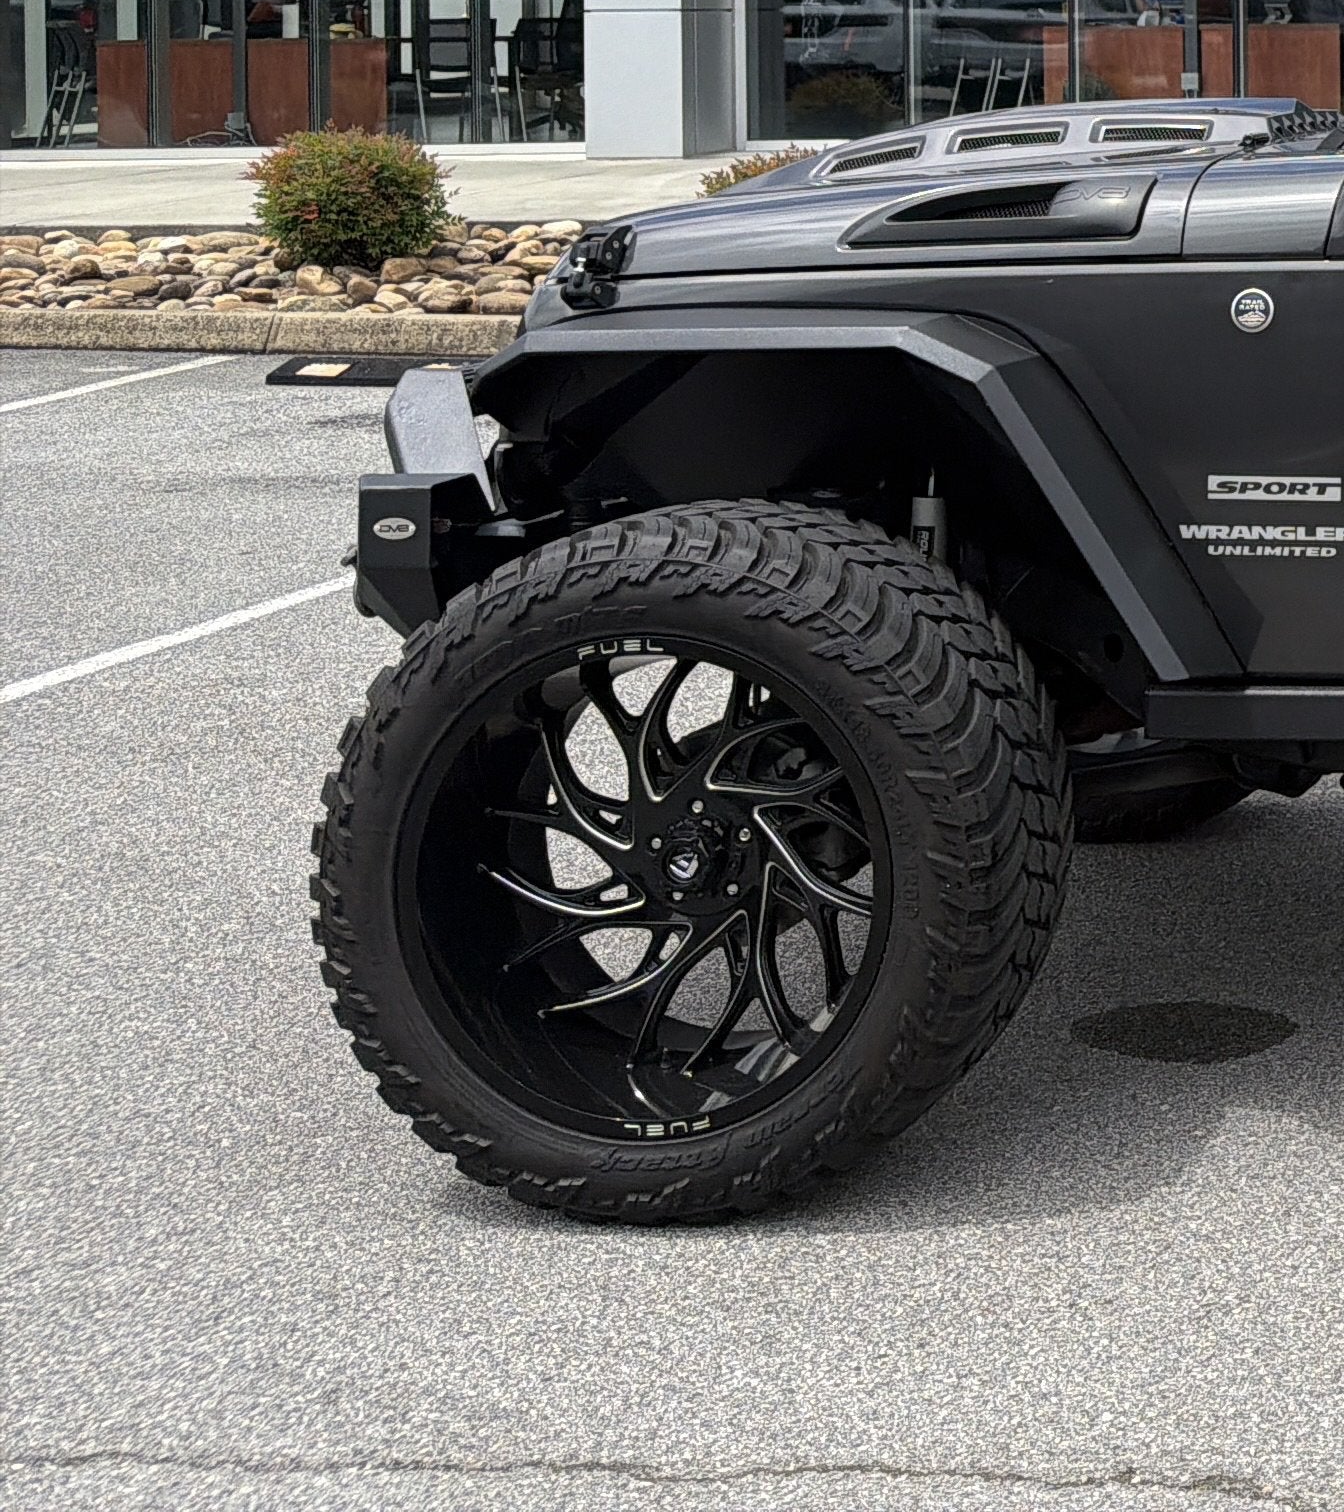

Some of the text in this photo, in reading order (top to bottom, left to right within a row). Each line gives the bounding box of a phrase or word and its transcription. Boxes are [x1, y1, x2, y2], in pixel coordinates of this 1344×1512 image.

[1214, 479, 1334, 497] SPORT
[1207, 545, 1338, 558] UNLIMITED
[575, 638, 665, 661] FUEL
[623, 1114, 711, 1137] FUEL
